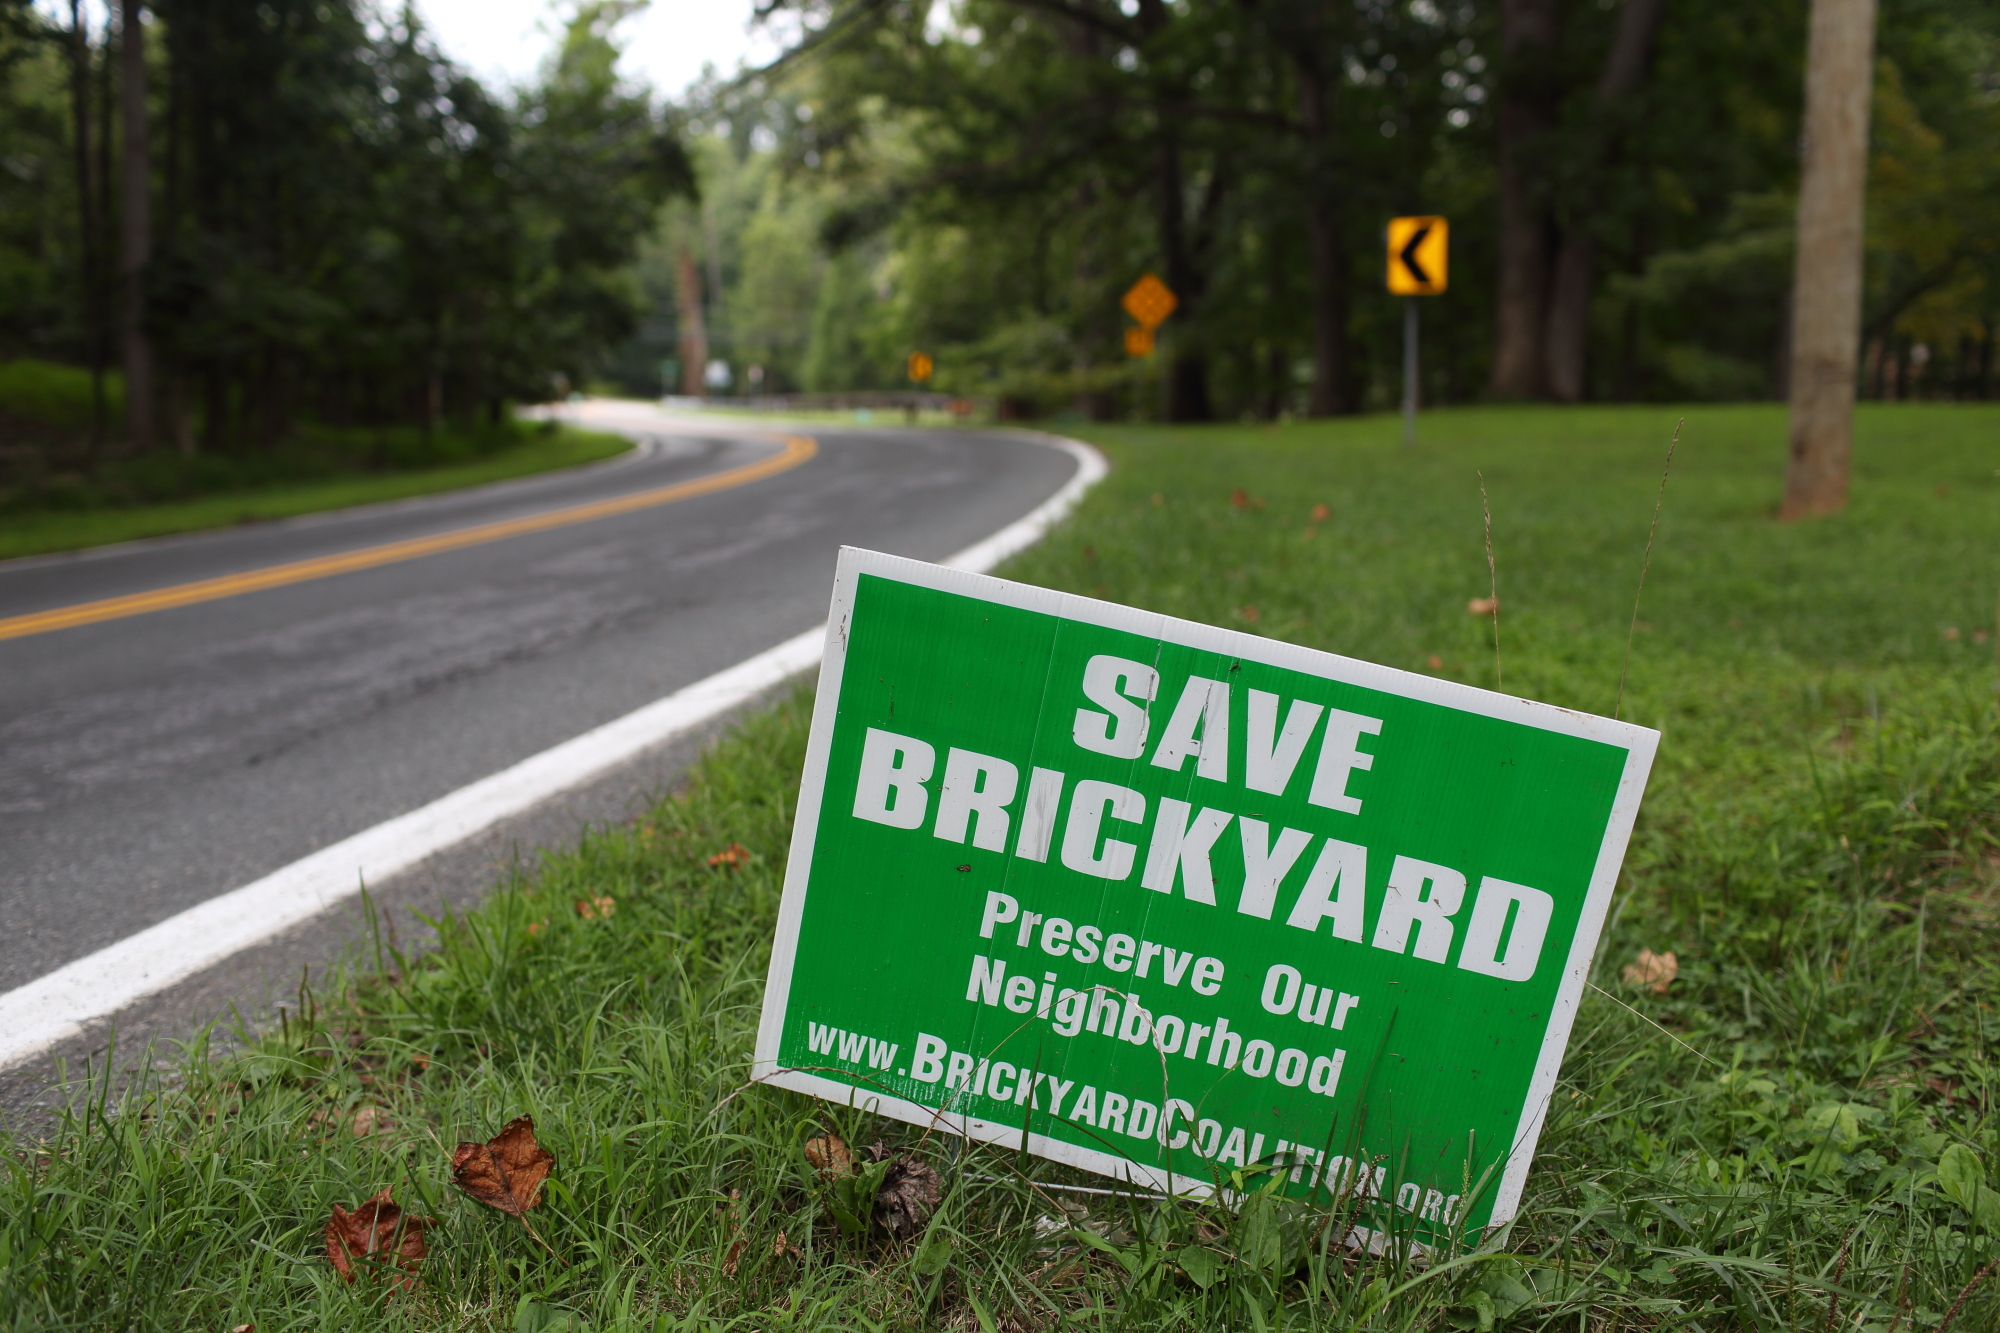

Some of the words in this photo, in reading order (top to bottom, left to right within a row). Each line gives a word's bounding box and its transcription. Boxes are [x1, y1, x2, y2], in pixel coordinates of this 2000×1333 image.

[1073, 654, 1384, 815] SAVE
[852, 727, 1554, 982] BRICKYARD
[966, 954, 1346, 1097] Neighborhood
[979, 890, 1225, 996] Preserve
[1261, 964, 1360, 1030] Our
